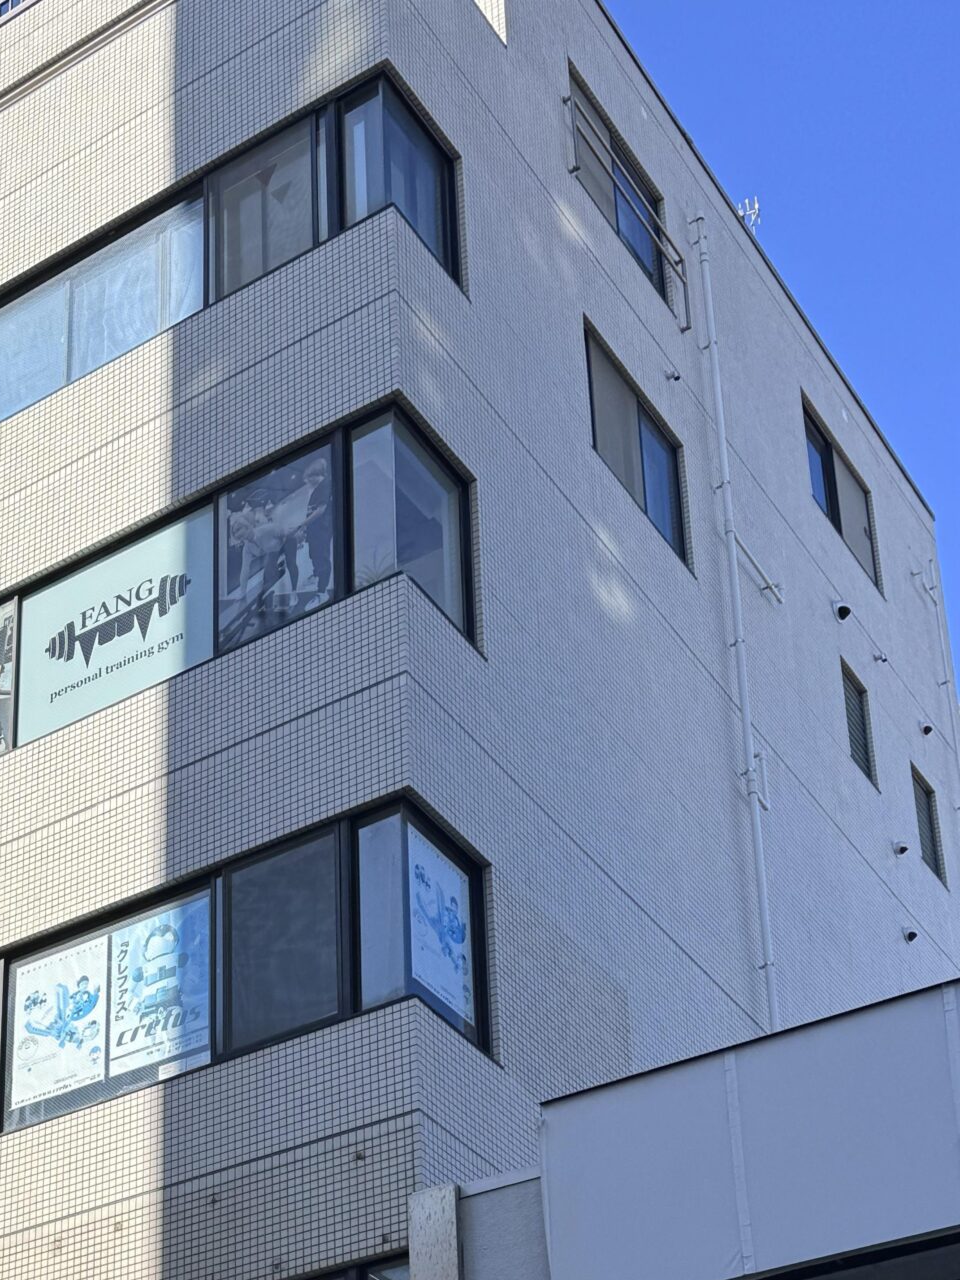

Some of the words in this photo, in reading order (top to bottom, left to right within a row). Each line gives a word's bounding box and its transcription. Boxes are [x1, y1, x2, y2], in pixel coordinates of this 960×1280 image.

[80, 578, 155, 631] FANG
[49, 667, 102, 703] personal
[105, 647, 155, 675] training
[157, 632, 184, 654] gym
